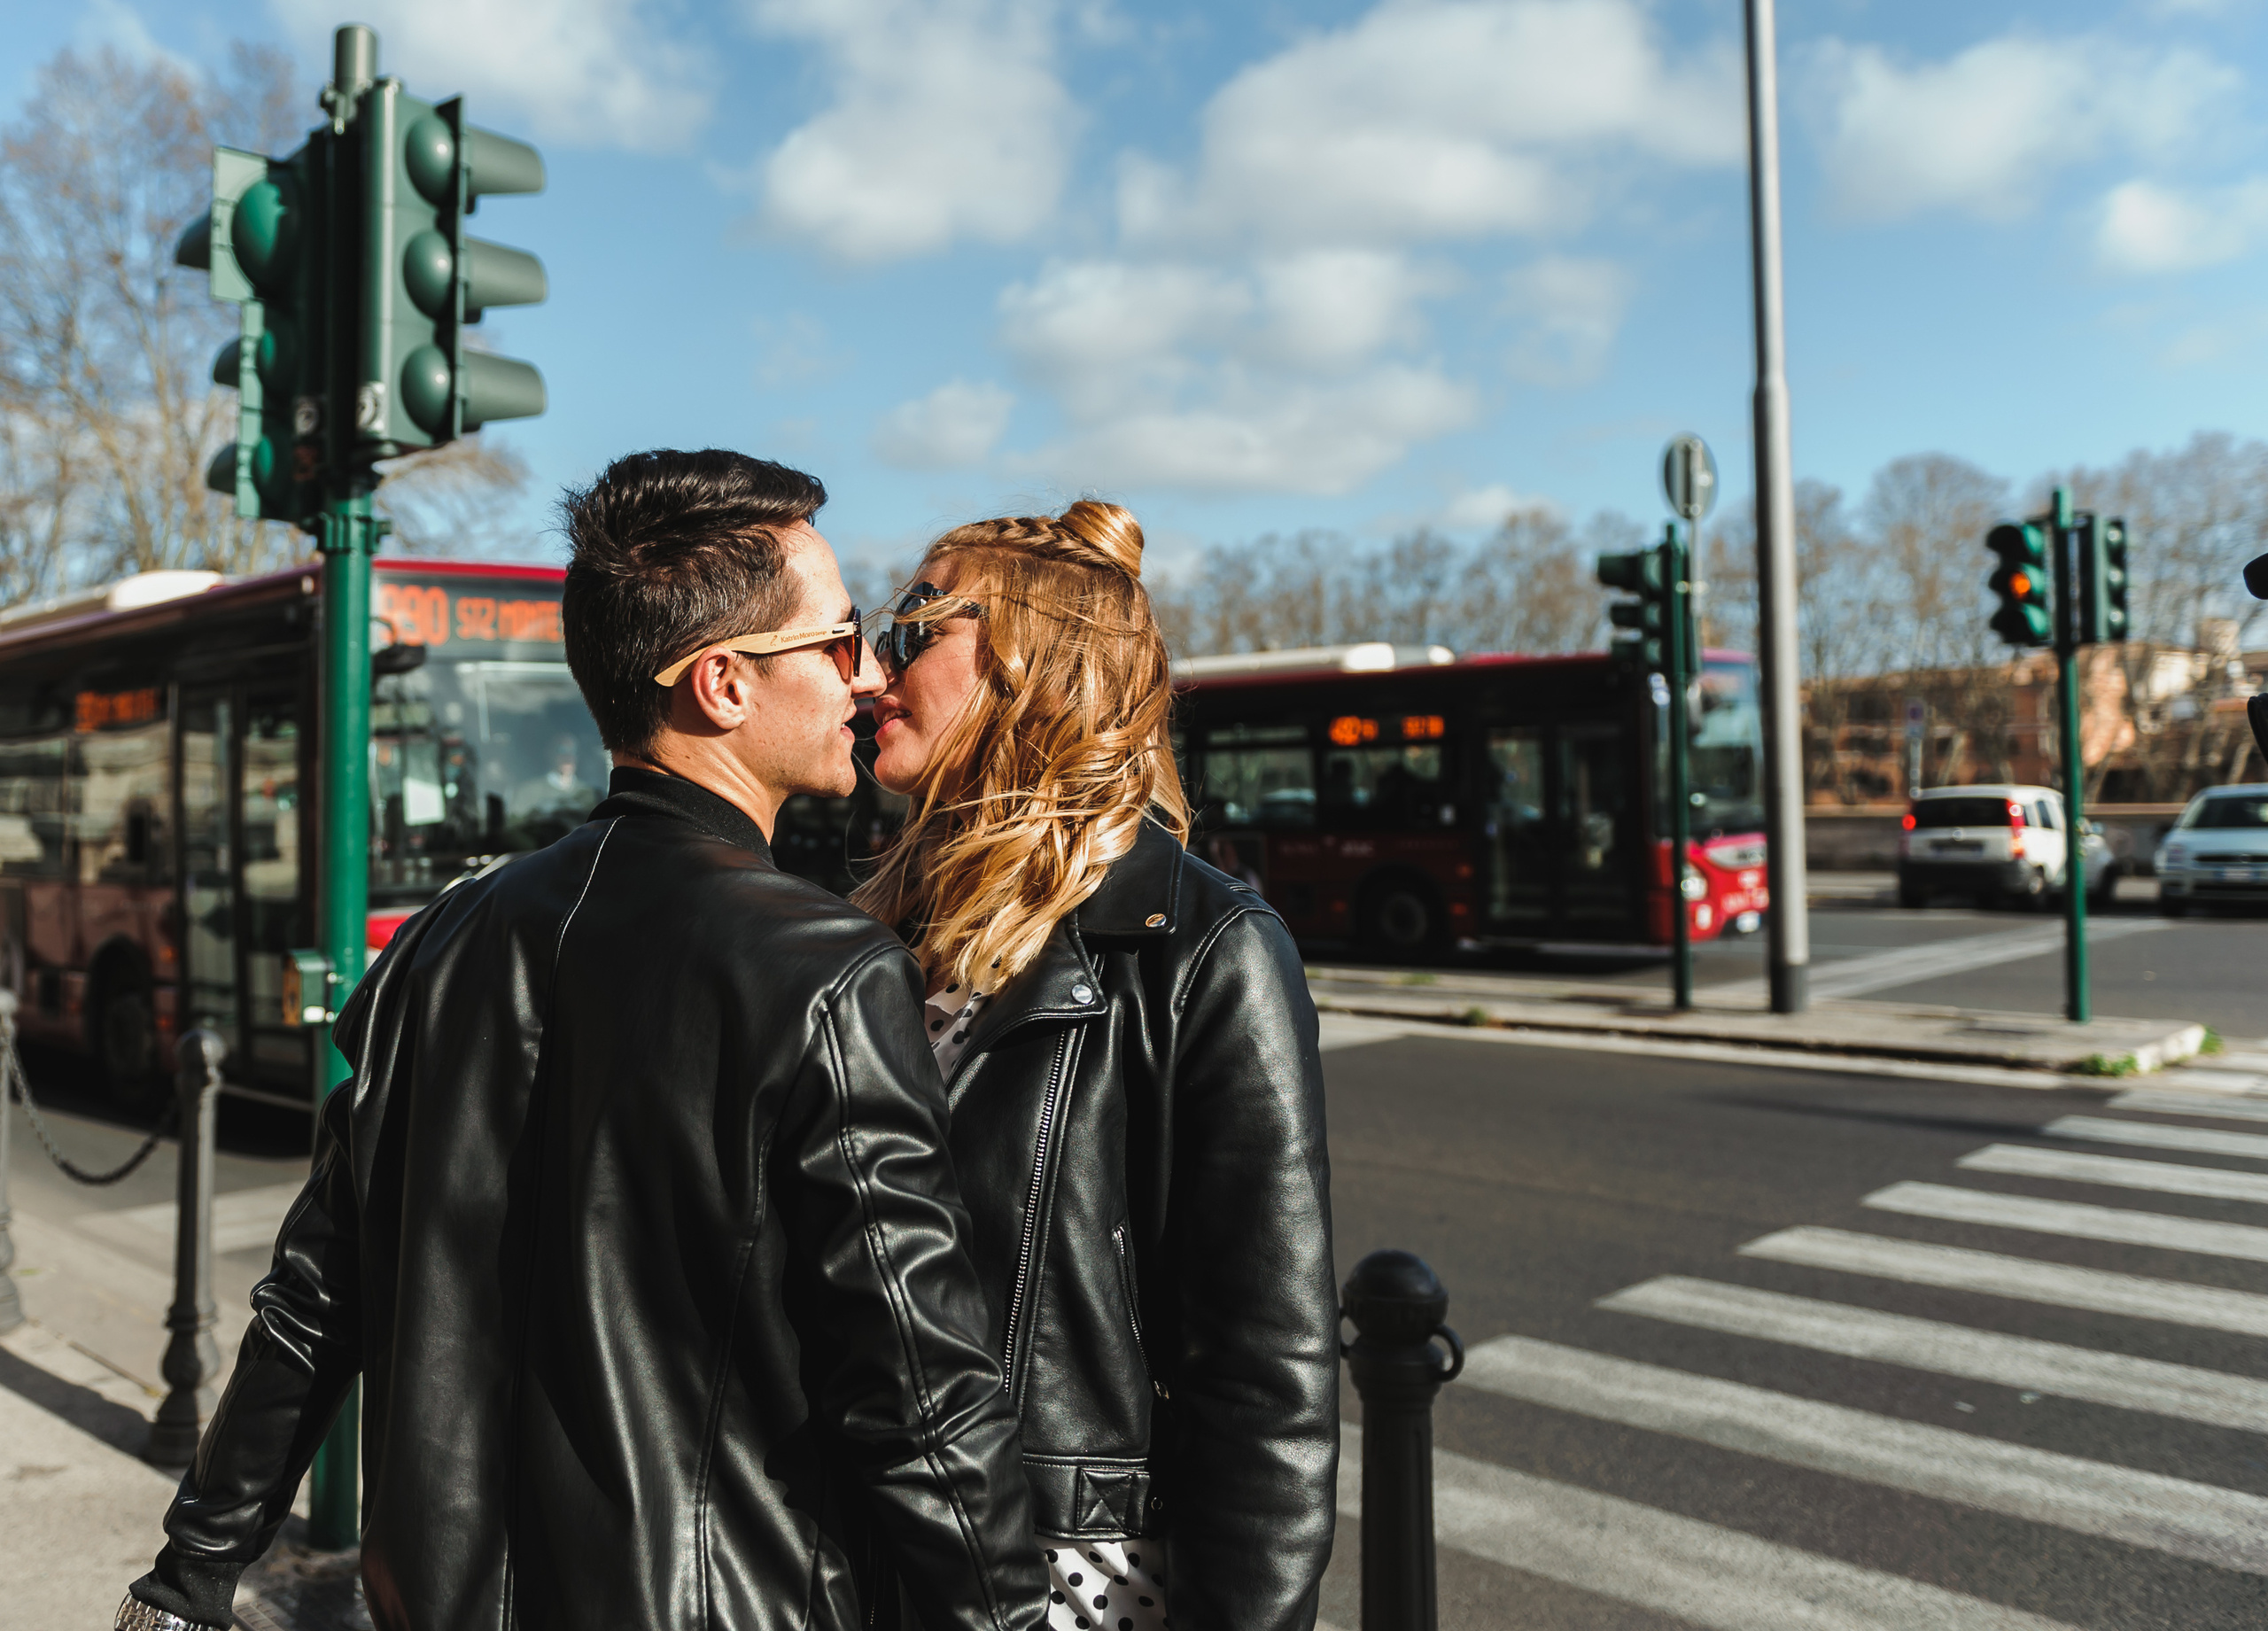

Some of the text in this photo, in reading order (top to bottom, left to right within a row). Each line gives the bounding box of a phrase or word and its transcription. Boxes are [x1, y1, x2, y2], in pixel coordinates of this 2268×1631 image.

[379, 583, 450, 647] 990
[781, 633, 800, 643] Katrin
[799, 631, 815, 640] Moro
